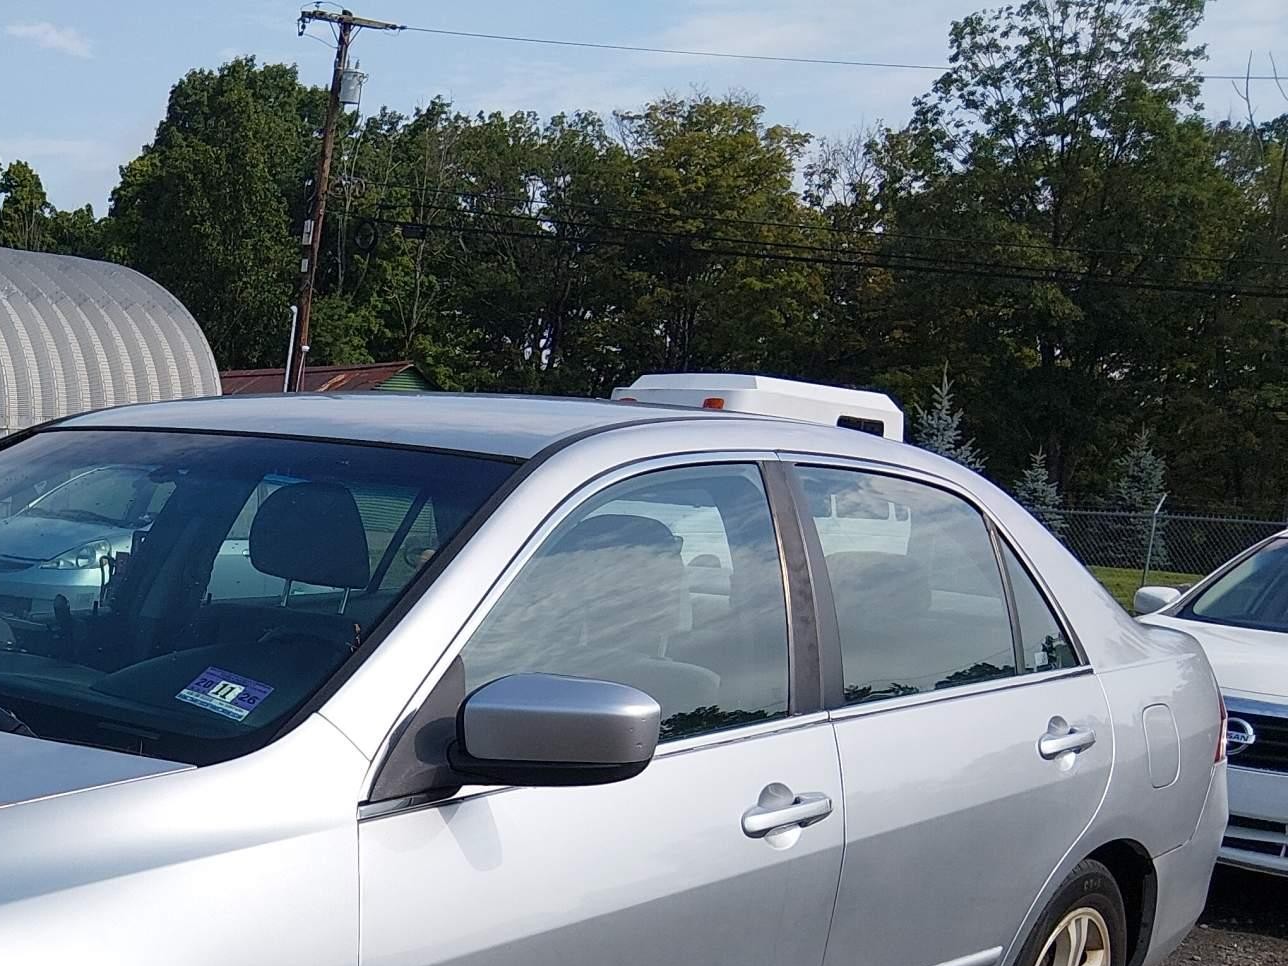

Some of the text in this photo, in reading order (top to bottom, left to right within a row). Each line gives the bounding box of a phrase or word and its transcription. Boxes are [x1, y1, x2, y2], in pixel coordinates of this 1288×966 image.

[195, 678, 215, 689] 20
[212, 682, 235, 700] 11
[1227, 731, 1249, 742] SAN
